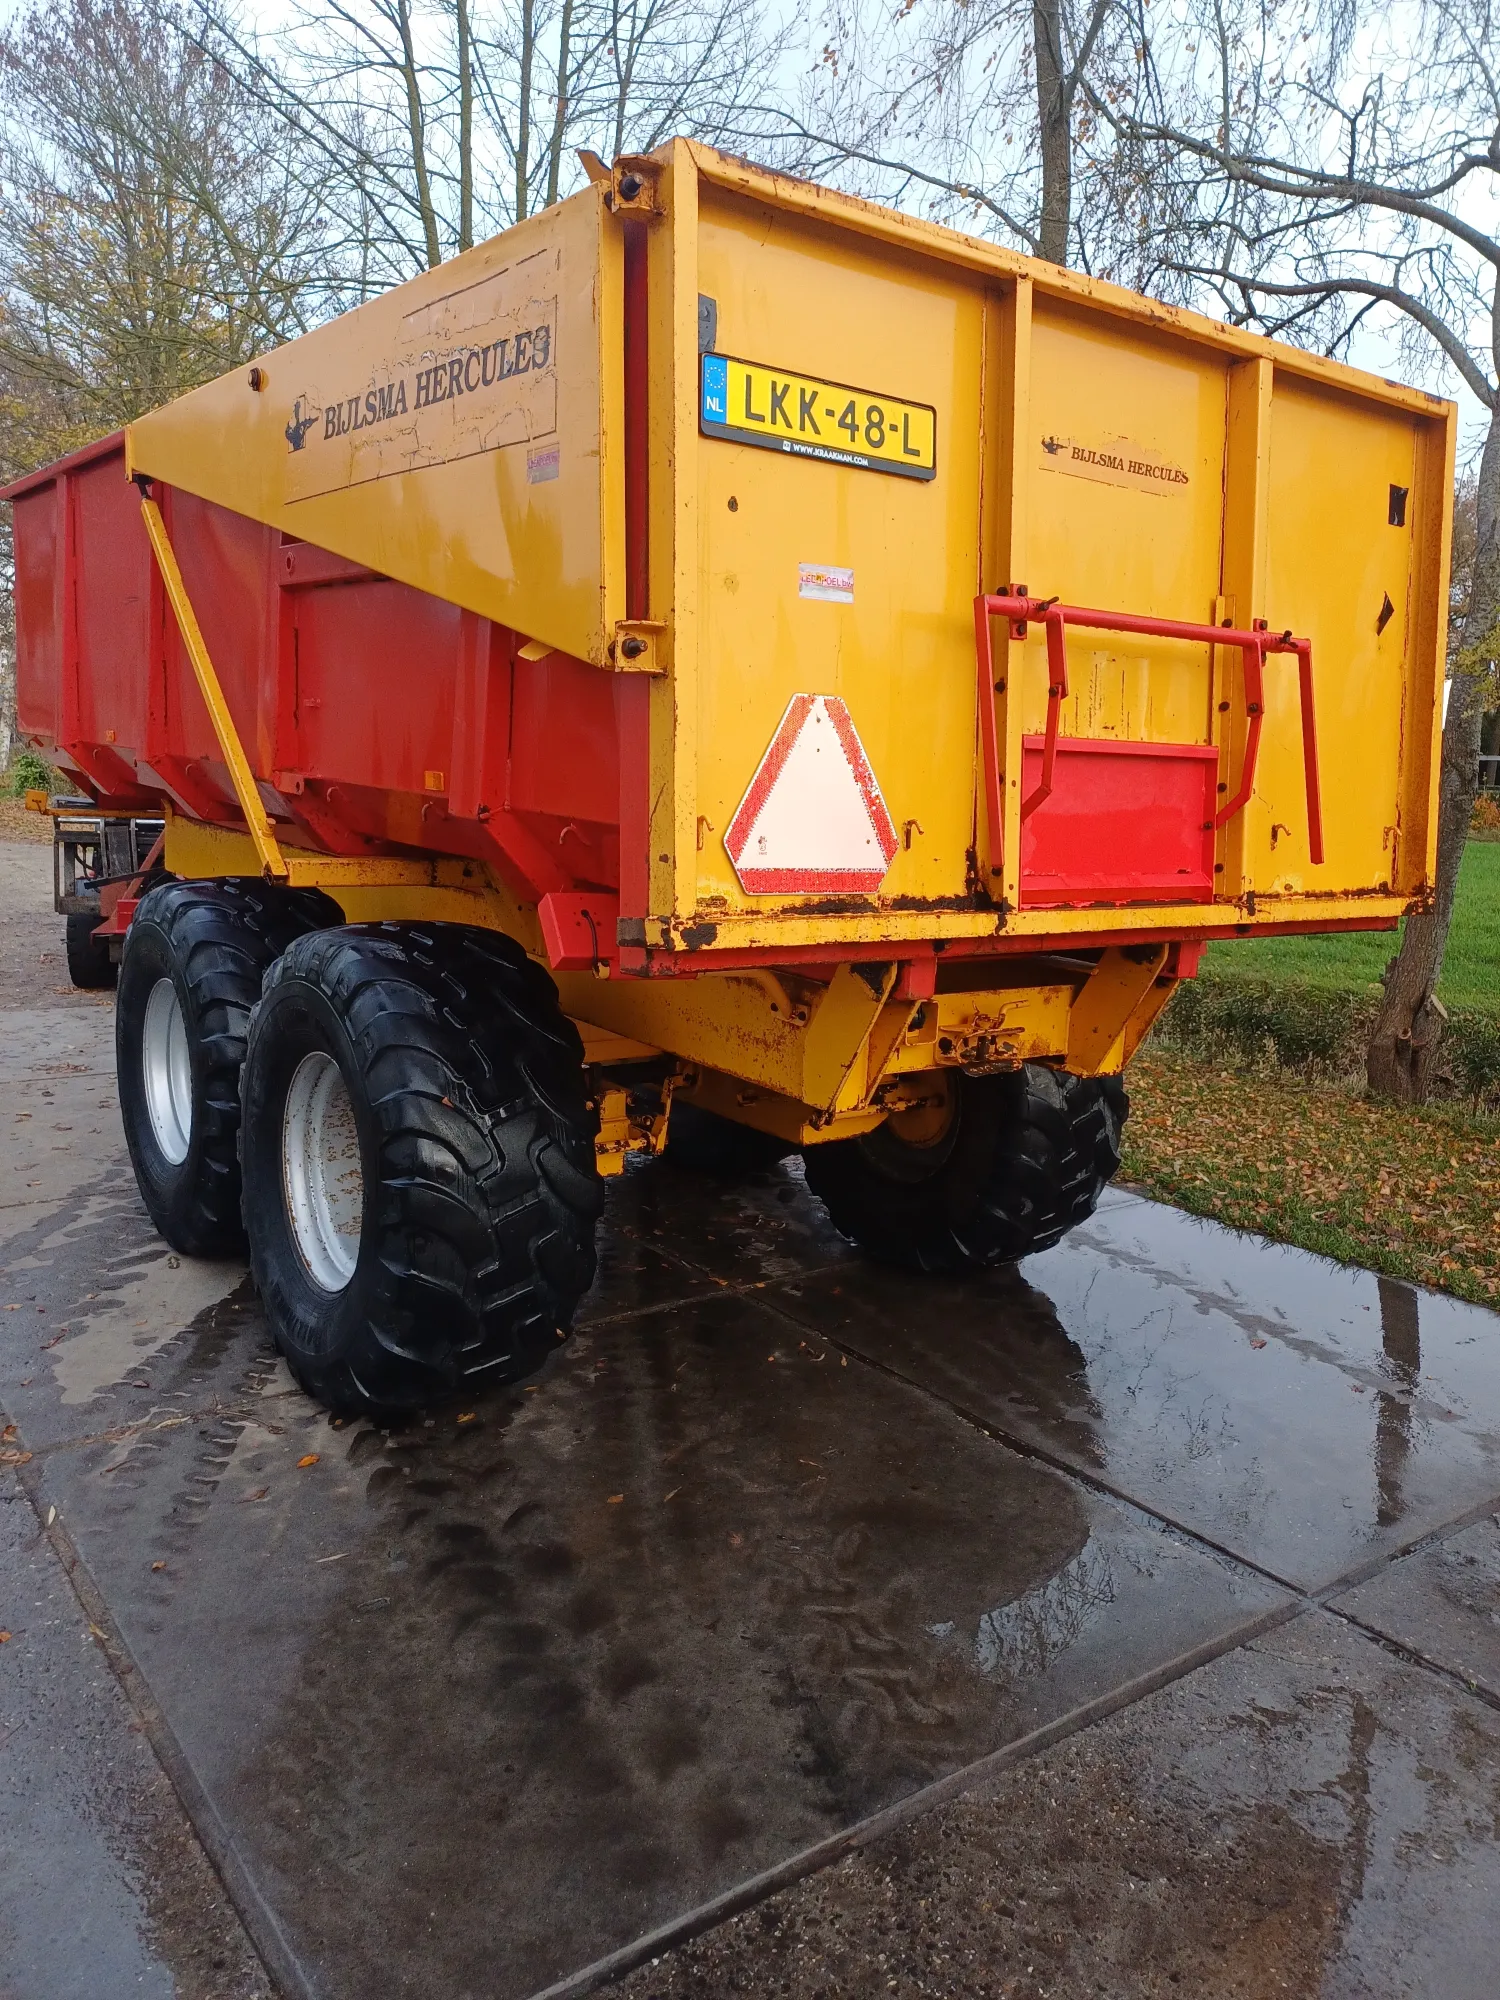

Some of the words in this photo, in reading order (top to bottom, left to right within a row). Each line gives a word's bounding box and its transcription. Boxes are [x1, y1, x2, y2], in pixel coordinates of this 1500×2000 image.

[324, 379, 408, 440] BIJLSMA
[414, 324, 550, 410] HERCULES
[706, 396, 724, 413] NL
[745, 374, 920, 457] LKK-48-L
[793, 443, 868, 466] WWW.KRAAKMAN.COM
[1071, 446, 1124, 471] BIJLSMA
[1128, 460, 1189, 485] HERCULES
